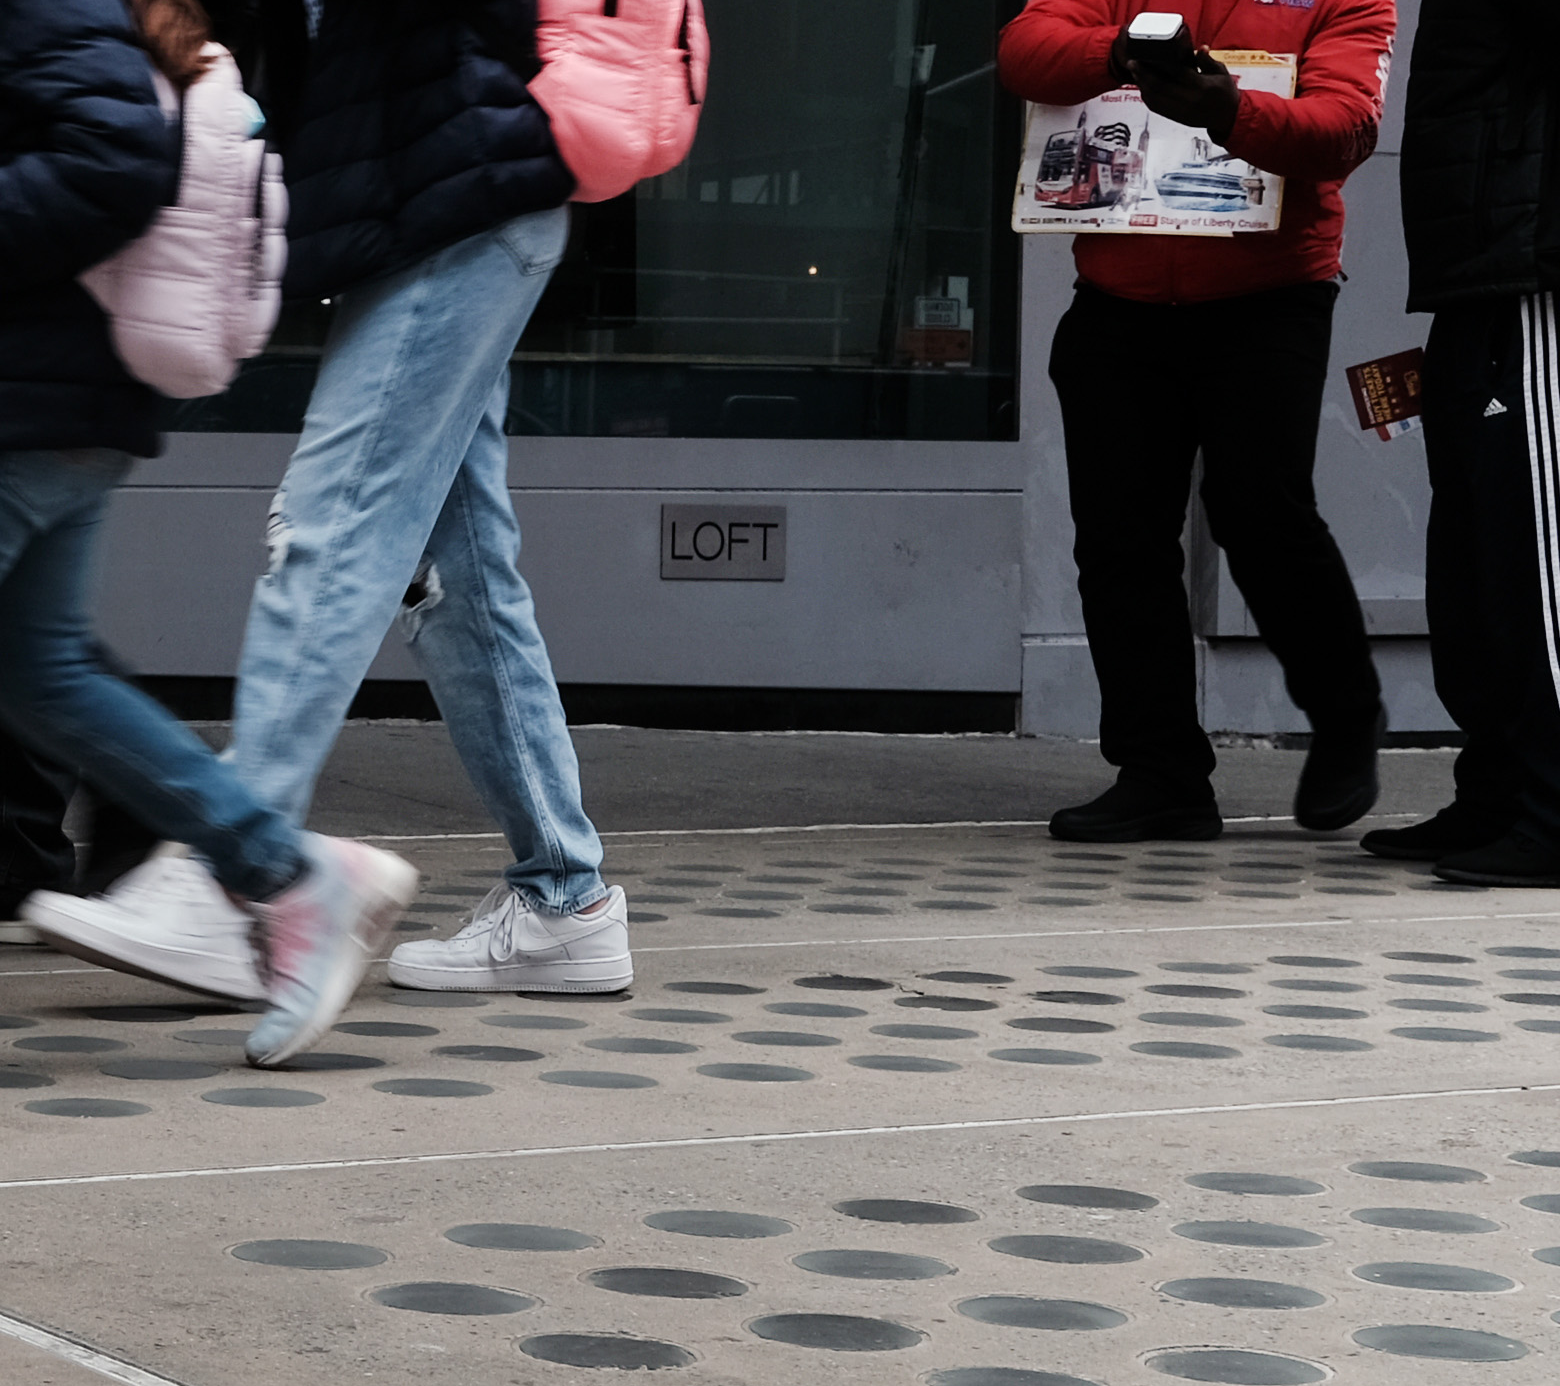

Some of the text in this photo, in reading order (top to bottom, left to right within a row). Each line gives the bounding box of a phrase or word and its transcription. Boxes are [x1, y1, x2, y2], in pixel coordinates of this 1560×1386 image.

[1203, 217, 1236, 229] Liberty
[1238, 218, 1269, 229] Cruise
[671, 521, 779, 562] LOFT
